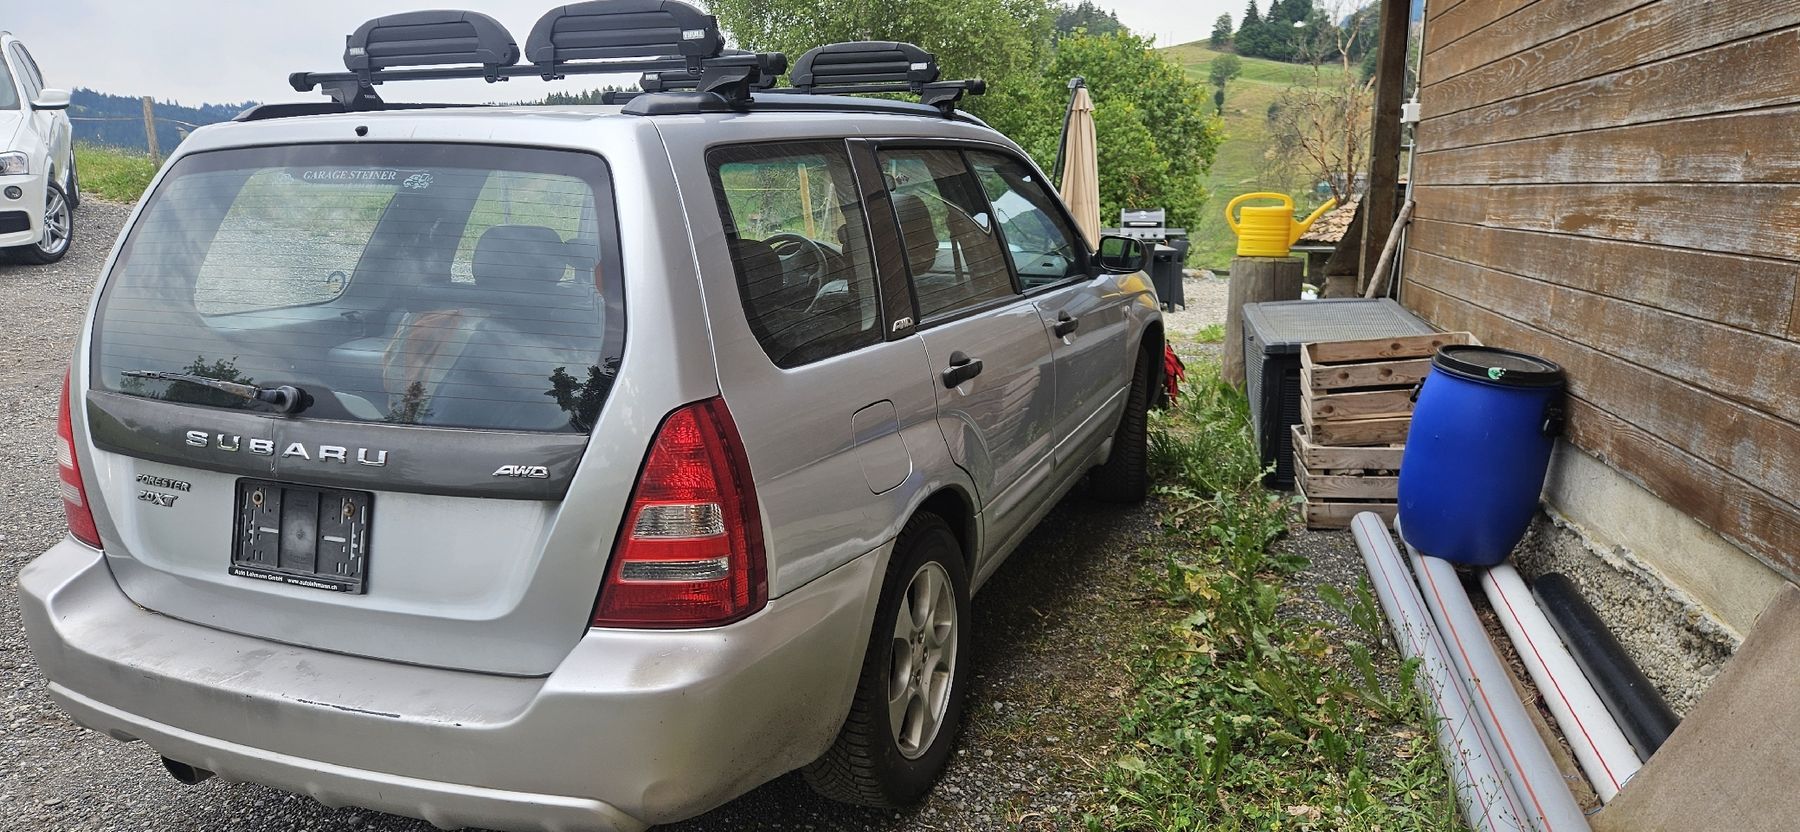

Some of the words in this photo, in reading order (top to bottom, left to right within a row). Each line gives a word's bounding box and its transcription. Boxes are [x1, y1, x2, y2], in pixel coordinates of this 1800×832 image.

[303, 170, 348, 180] GARAGE
[349, 170, 397, 180] STEINER
[186, 430, 389, 468] SUBARU
[492, 464, 550, 479] AWD
[136, 473, 191, 492] FORESTER
[268, 574, 283, 582] GmbH
